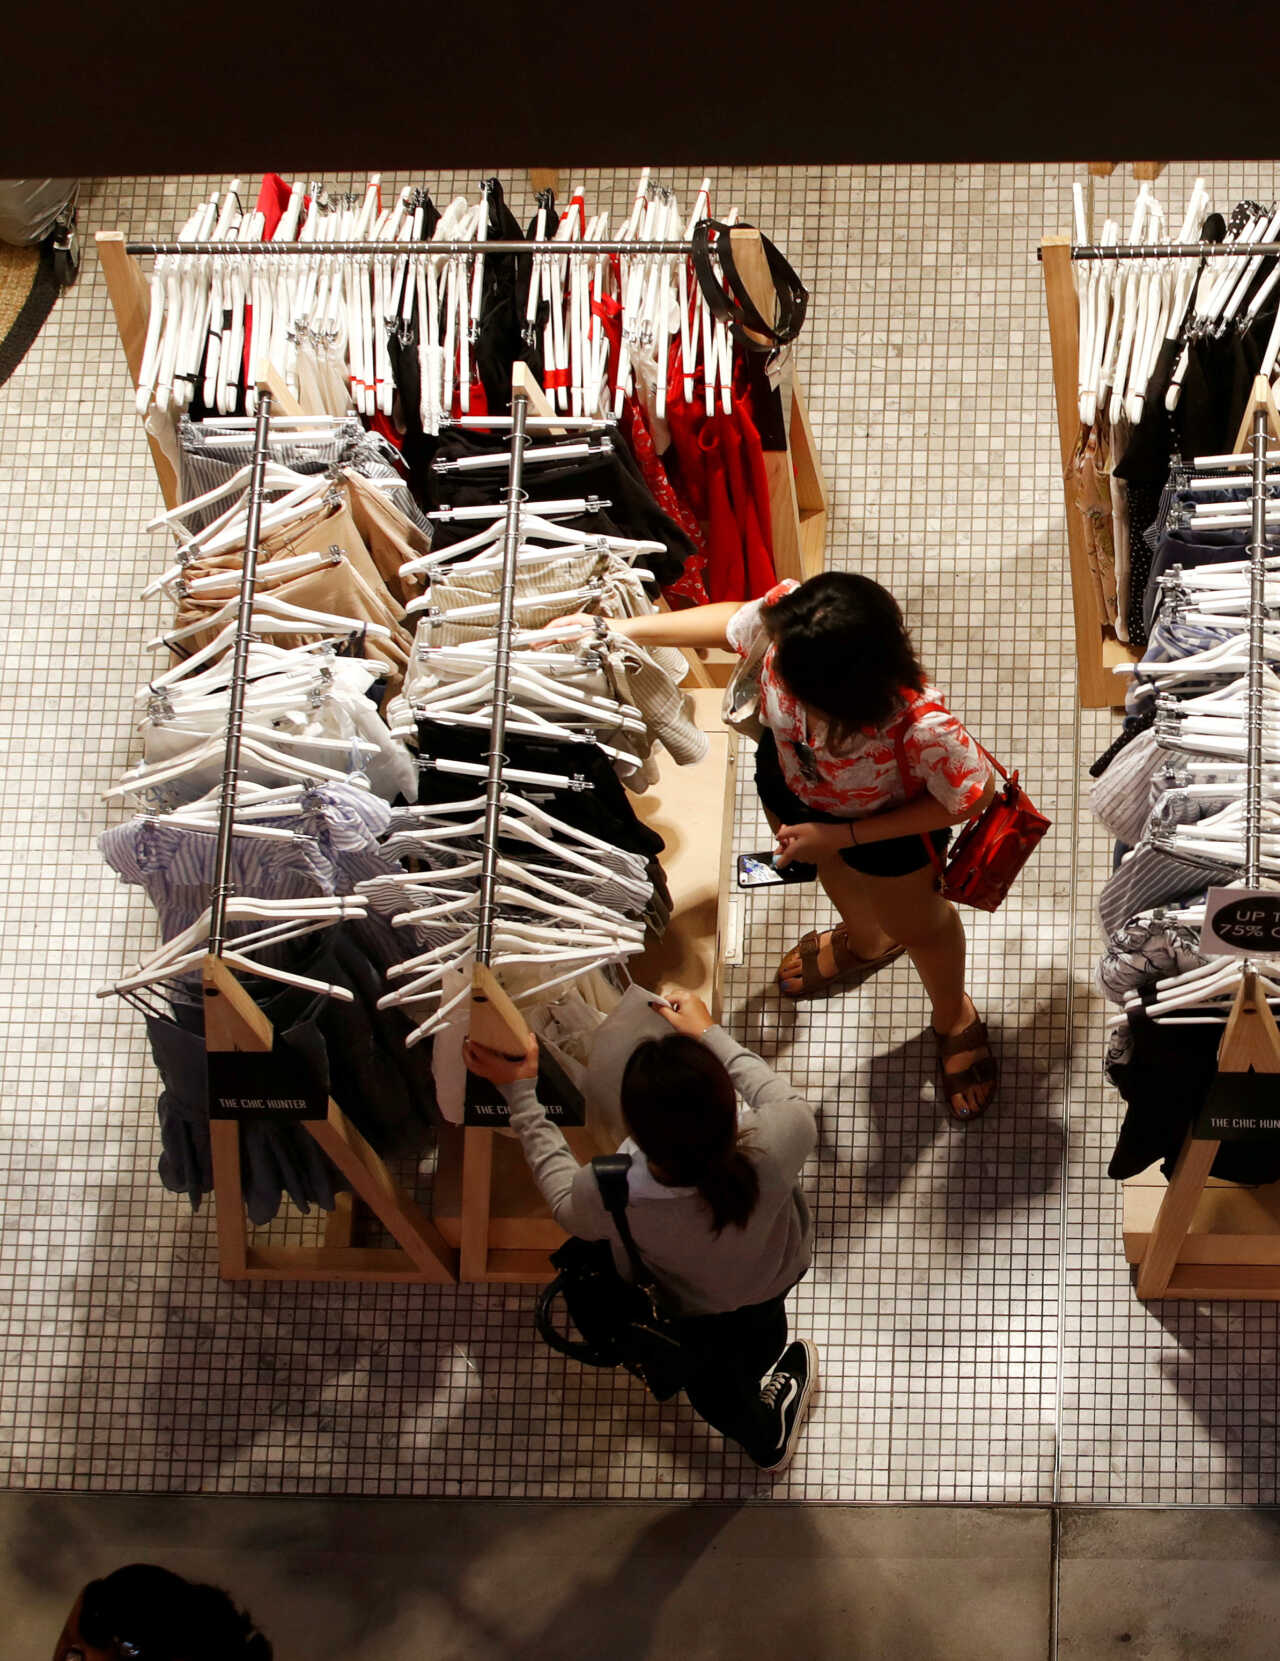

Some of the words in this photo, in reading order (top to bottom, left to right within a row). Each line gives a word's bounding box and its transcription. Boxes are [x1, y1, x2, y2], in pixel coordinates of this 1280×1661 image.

[1236, 910, 1265, 922] UP
[1219, 923, 1264, 937] 75%
[218, 1098, 240, 1108] THE
[240, 1099, 265, 1109] CHIC
[266, 1099, 307, 1109] HUNTER
[474, 1105, 496, 1115] THE
[1210, 1118, 1229, 1128] THE
[1232, 1118, 1256, 1128] CHIC
